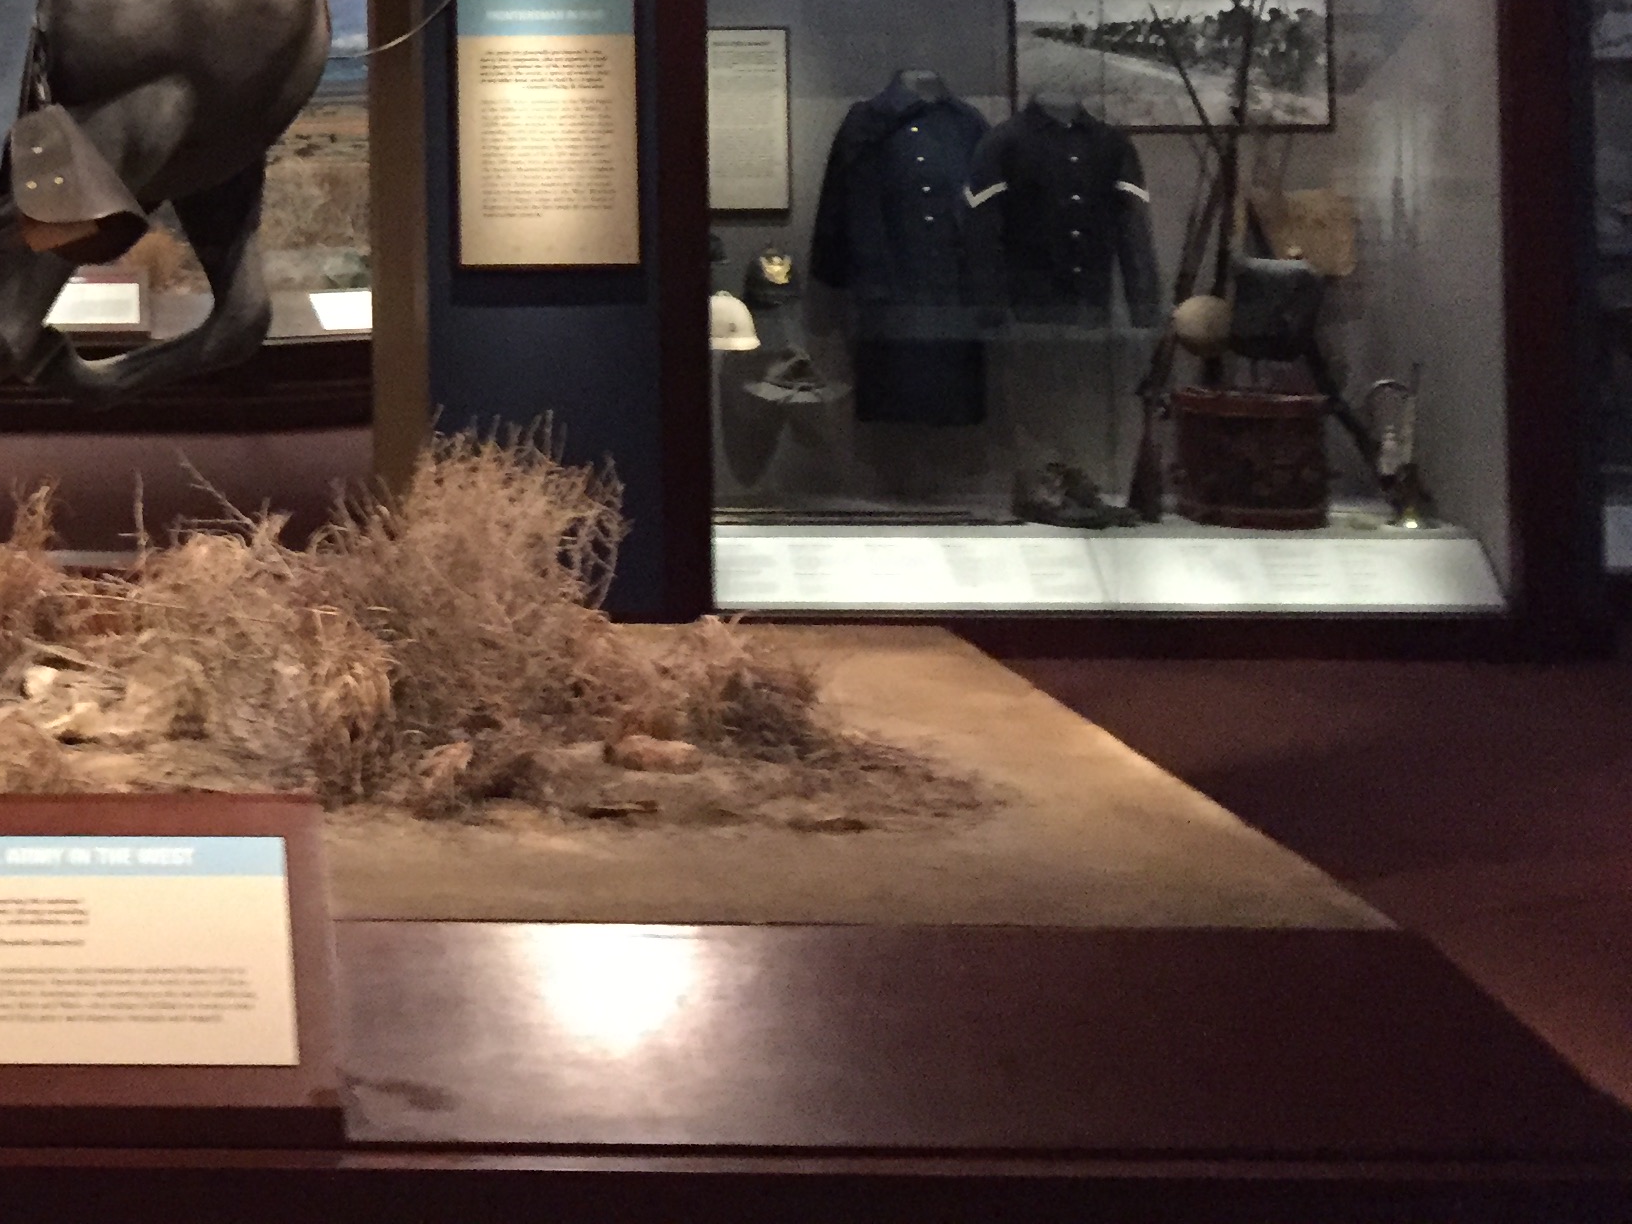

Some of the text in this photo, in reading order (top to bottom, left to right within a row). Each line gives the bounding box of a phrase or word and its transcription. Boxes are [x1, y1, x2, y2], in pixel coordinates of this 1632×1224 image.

[67, 847, 91, 866] IN
[95, 846, 131, 866] THE
[136, 846, 194, 866] WEST
